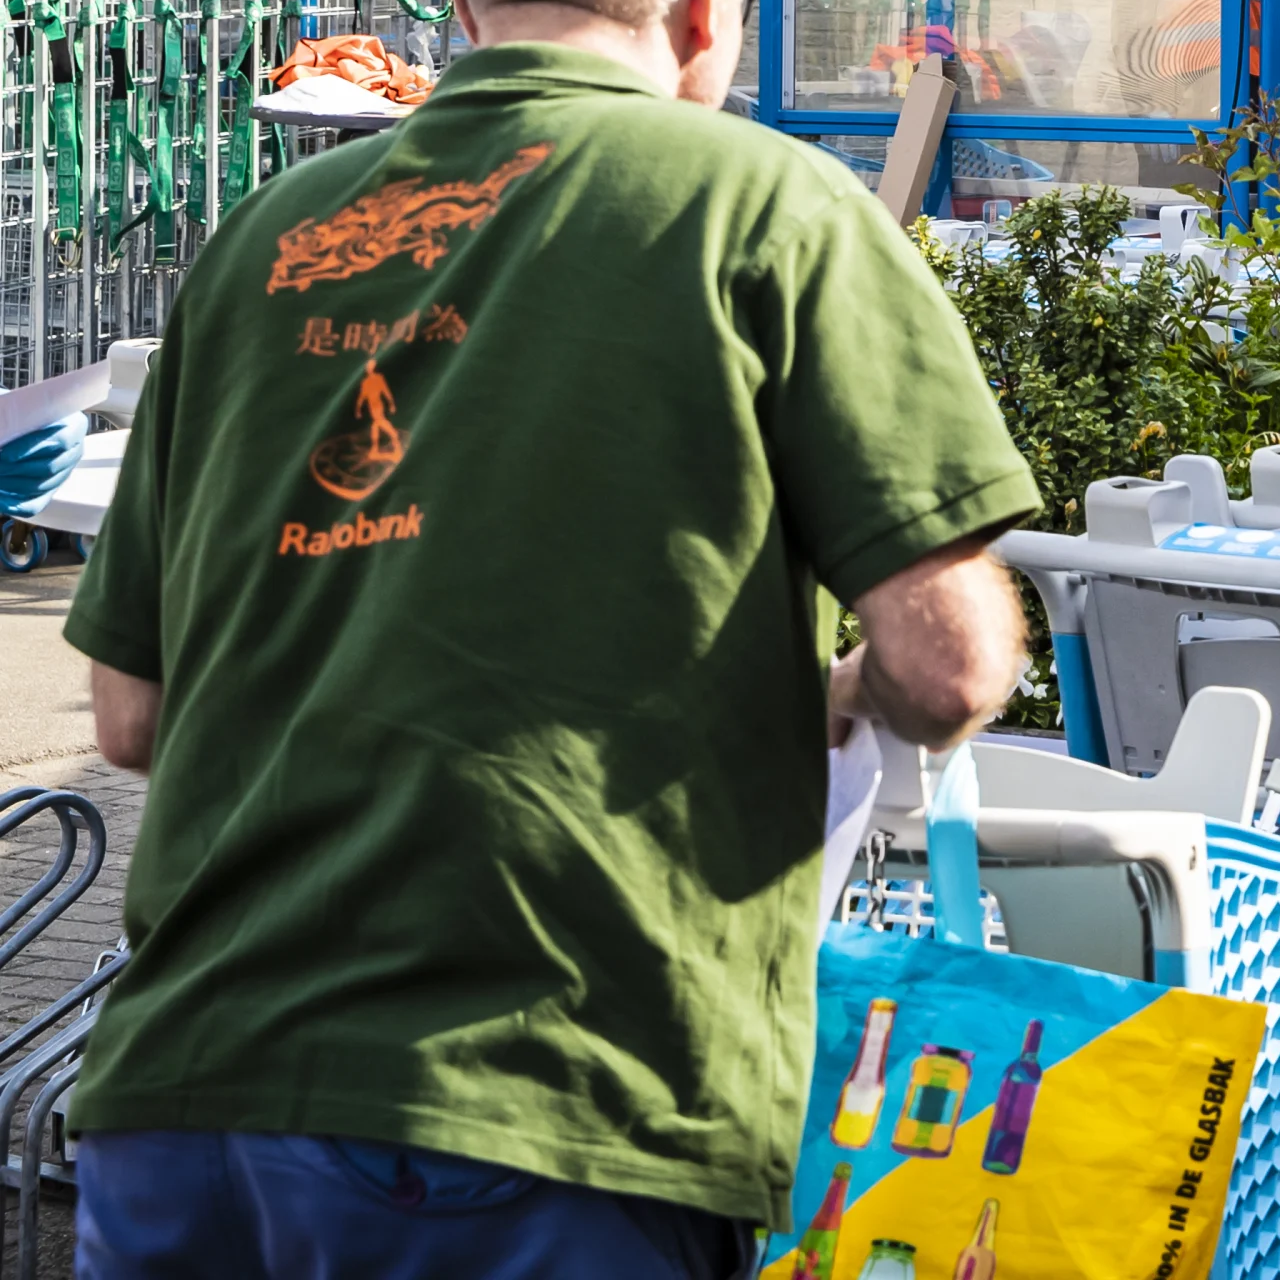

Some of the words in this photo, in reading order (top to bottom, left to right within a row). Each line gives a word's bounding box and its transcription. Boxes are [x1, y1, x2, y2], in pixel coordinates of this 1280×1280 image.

[1189, 1056, 1236, 1162] GLASBAK
[1175, 1169, 1203, 1199] DE
[1168, 1204, 1190, 1232] IN
